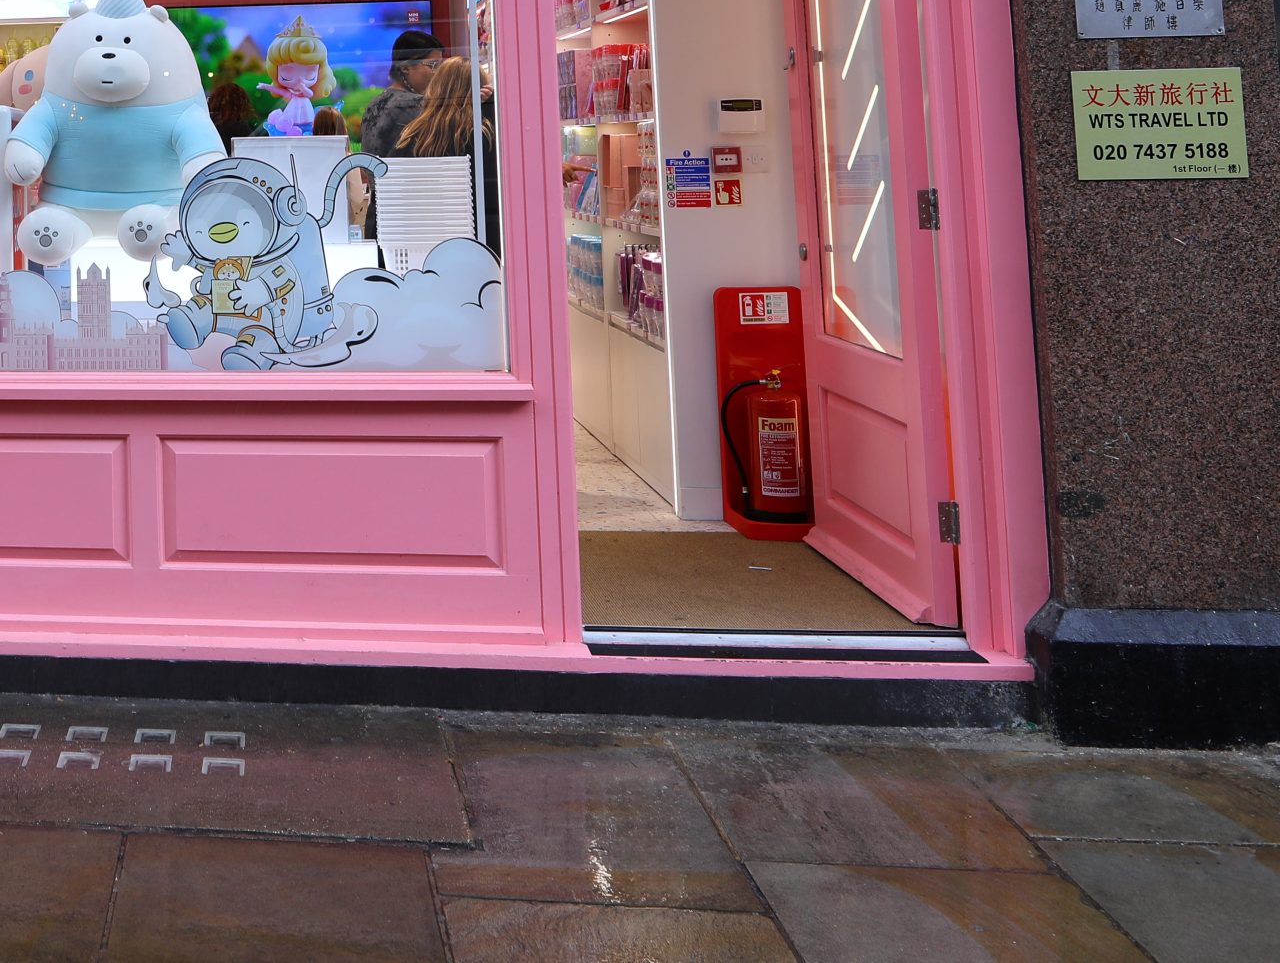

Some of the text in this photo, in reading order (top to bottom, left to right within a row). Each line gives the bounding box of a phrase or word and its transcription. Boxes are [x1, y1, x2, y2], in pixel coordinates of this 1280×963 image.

[1082, 81, 1235, 108] 文大新旅行社
[1089, 111, 1229, 128] WTS TRAVEL LTD
[1093, 142, 1229, 160] 020 7437 5188
[1173, 164, 1187, 173] 1st
[1188, 164, 1211, 173] Floor
[761, 419, 795, 432] Foam
